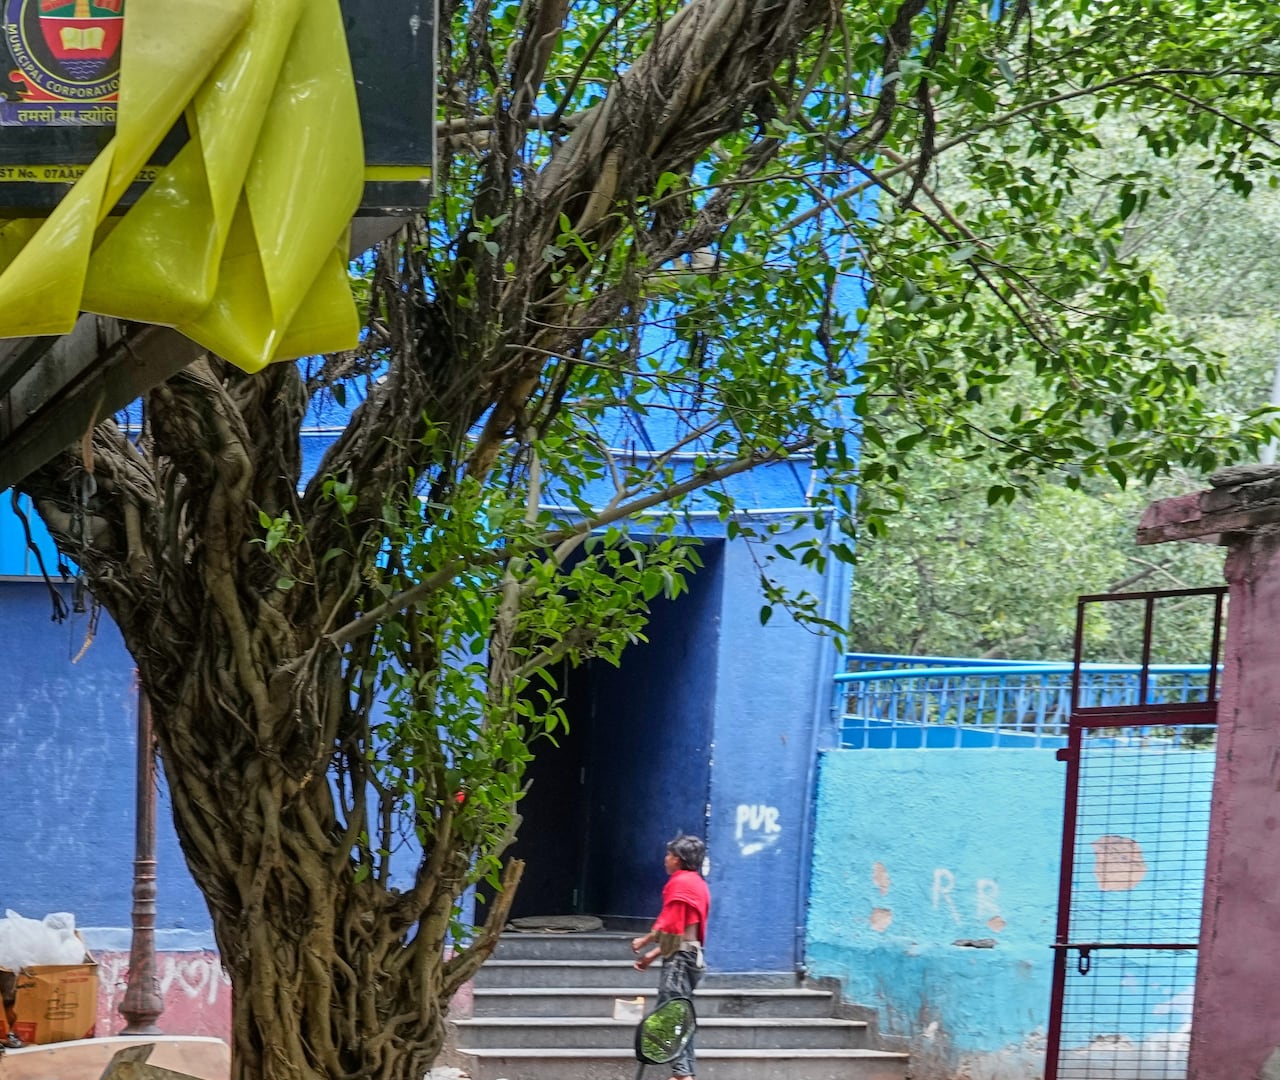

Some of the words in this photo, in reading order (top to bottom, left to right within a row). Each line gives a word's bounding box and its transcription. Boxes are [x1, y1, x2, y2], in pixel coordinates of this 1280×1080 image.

[8, 24, 43, 83] MUNICIPAL
[17, 106, 56, 122] तमसो
[18, 168, 37, 178] No.
